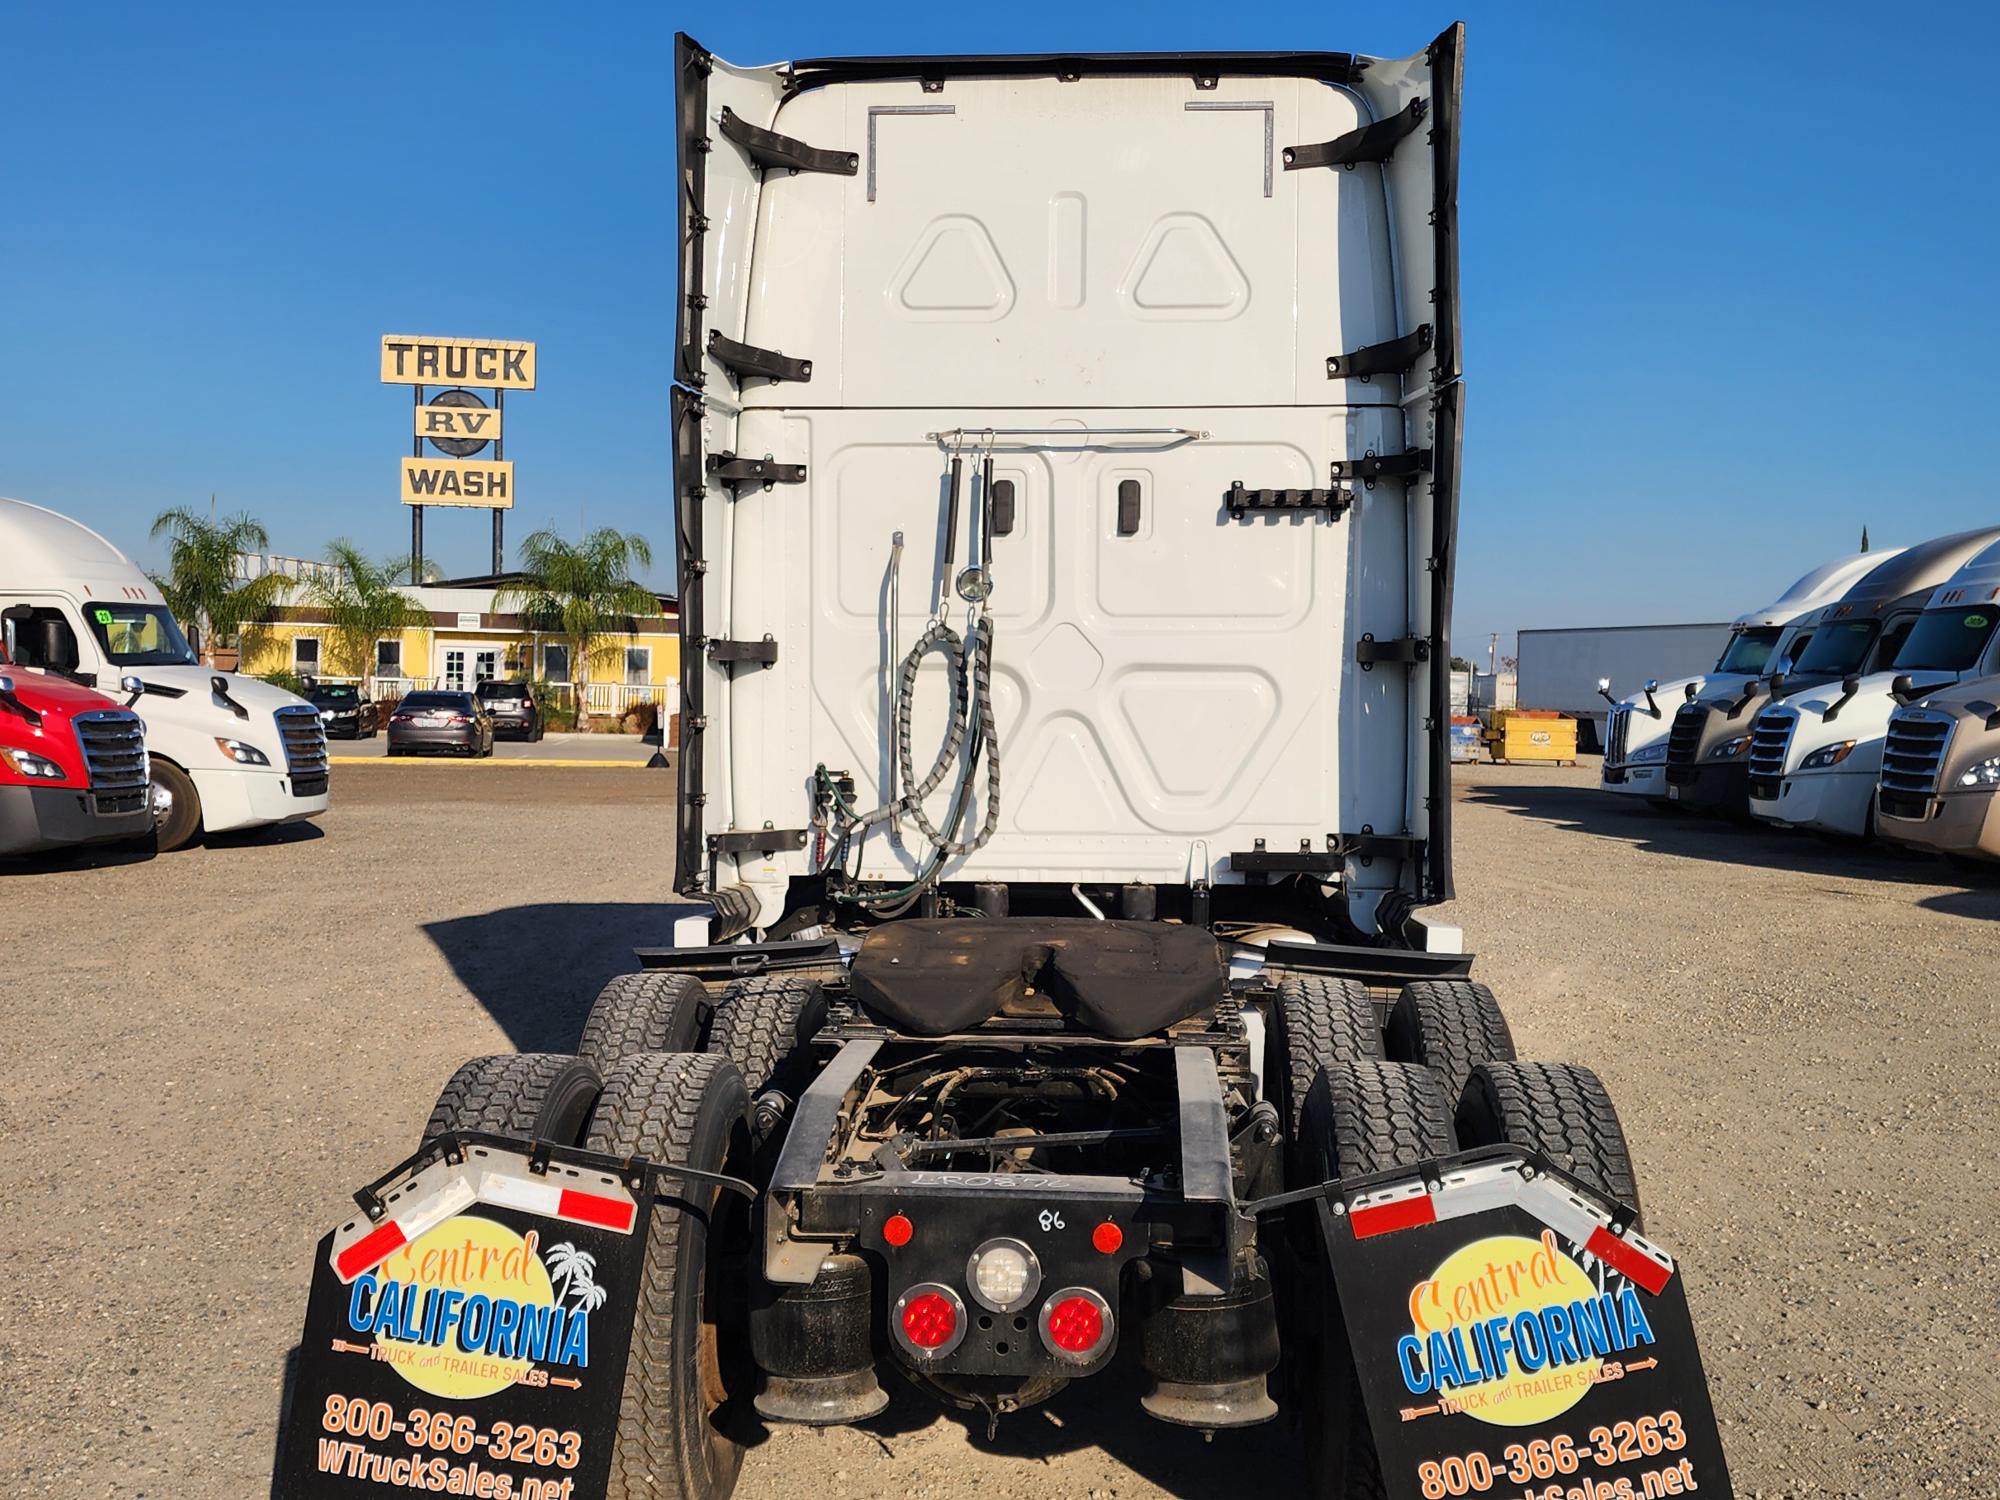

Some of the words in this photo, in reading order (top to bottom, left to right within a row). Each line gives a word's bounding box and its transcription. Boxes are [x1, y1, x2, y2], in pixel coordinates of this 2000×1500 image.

[388, 343, 528, 382] TRUCK
[425, 411, 491, 434] RV
[408, 468, 507, 498] WASH
[1038, 1209, 1066, 1232] 86
[378, 1229, 541, 1288] Central
[1408, 1228, 1568, 1335] Central
[348, 1273, 589, 1369] CALIFORNIA
[1397, 1287, 1656, 1395] CALIFORNIA
[369, 1343, 415, 1367] TRUCK
[419, 1352, 441, 1369] and
[443, 1356, 499, 1380] TRAILER
[502, 1366, 549, 1388] SALES
[1438, 1390, 1488, 1416] TRUCK
[1492, 1385, 1512, 1406] and
[1514, 1377, 1574, 1400] TRAILER
[1577, 1360, 1625, 1386] SALES
[321, 1393, 582, 1470] 800-366-3263
[1418, 1410, 1687, 1500] 800-366-3263
[317, 1437, 575, 1500] WTruckSales.net
